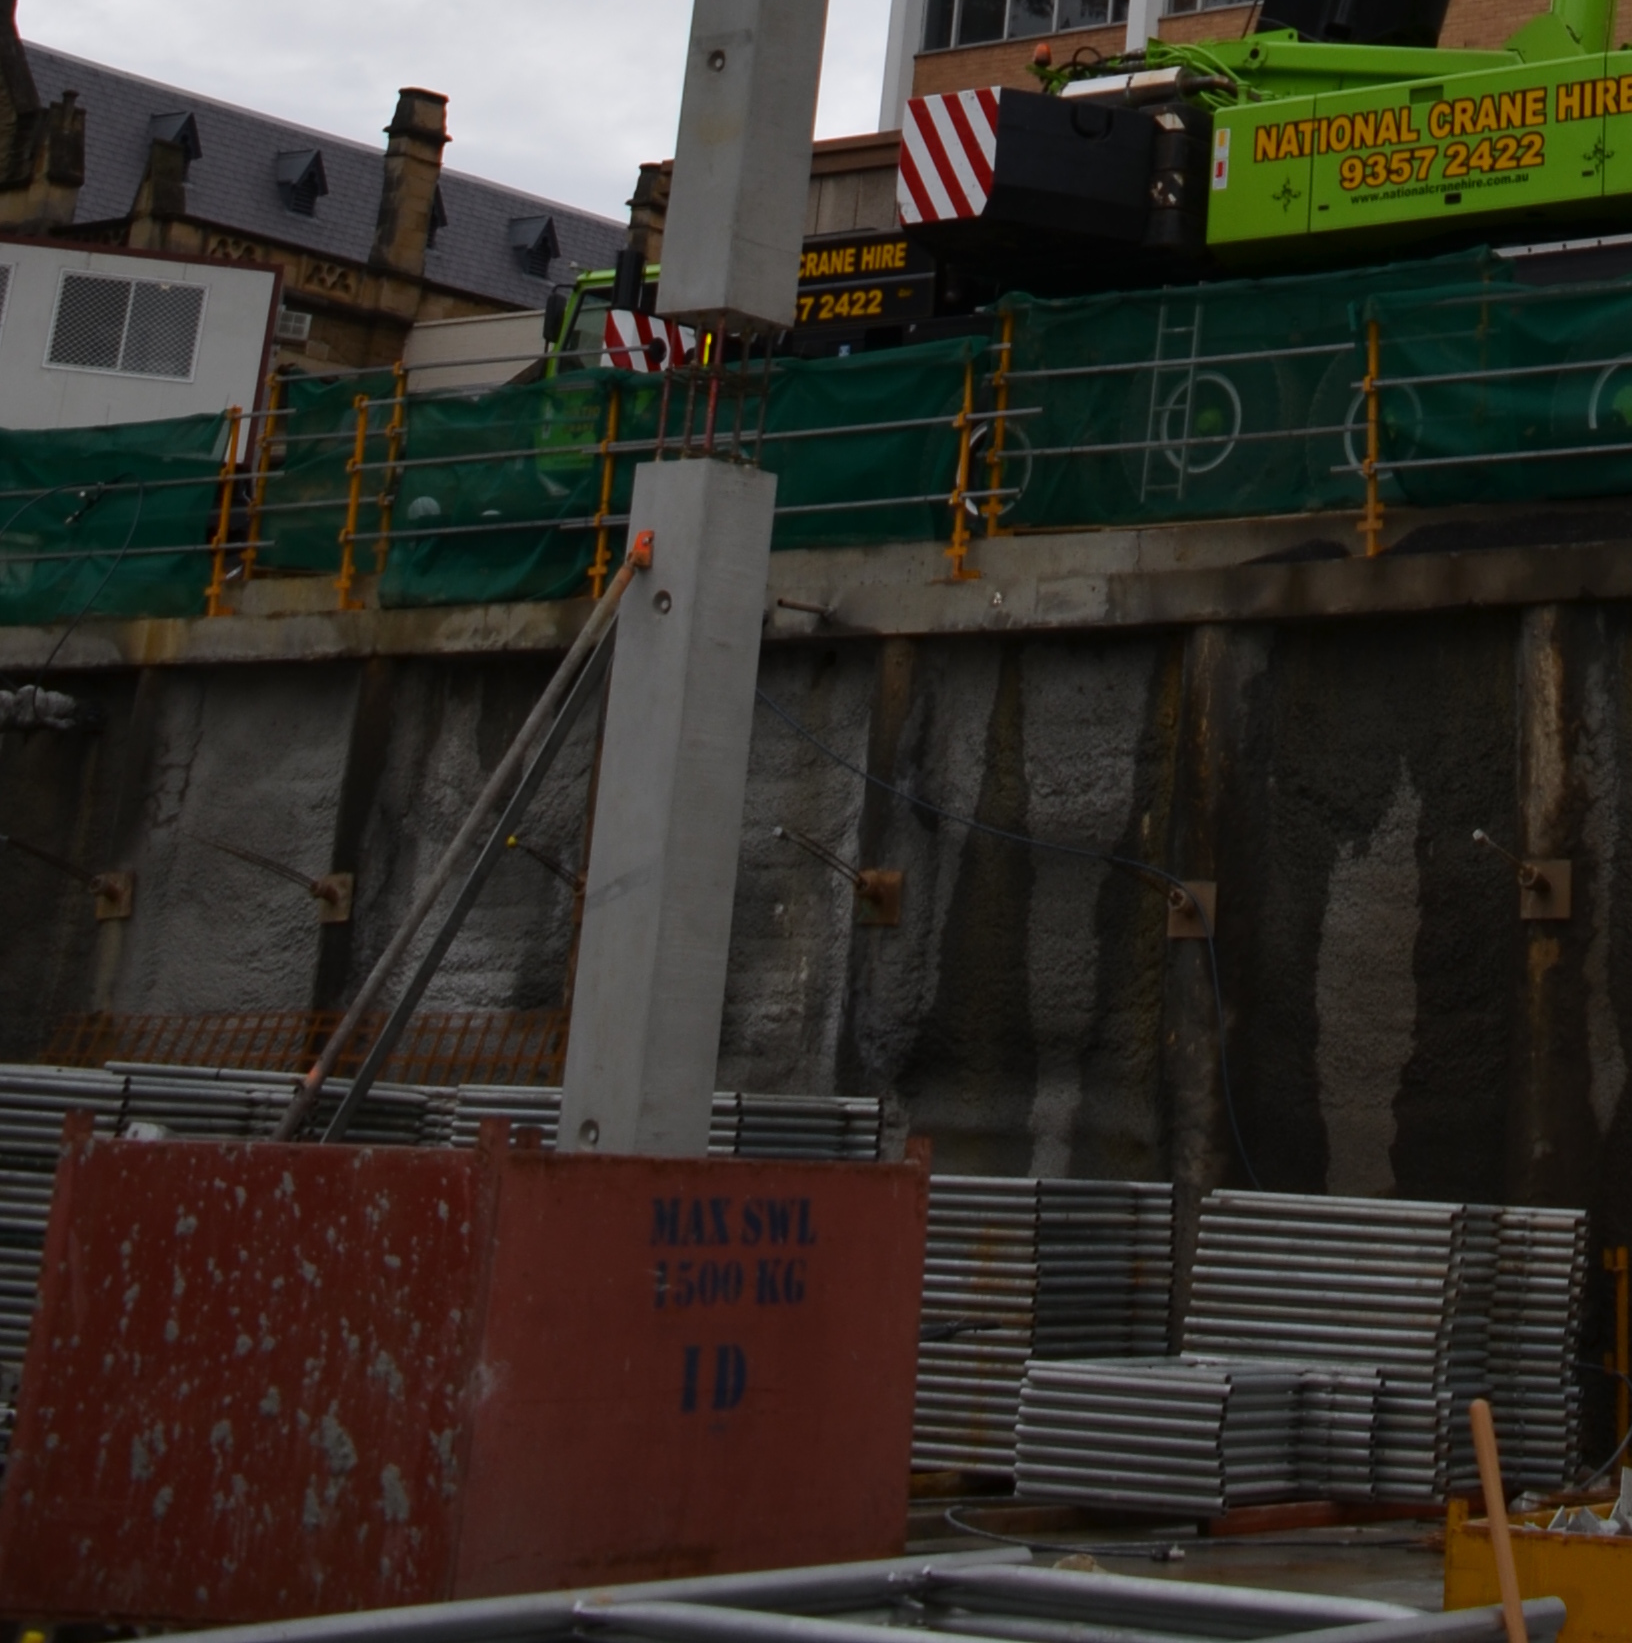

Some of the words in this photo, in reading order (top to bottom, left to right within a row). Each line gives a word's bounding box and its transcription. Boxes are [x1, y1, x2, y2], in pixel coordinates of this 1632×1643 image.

[1254, 105, 1420, 163] NATIONAL
[1428, 86, 1547, 139] CRANE
[1340, 146, 1439, 191] 9357
[1443, 132, 1545, 179] 2422
[1350, 172, 1530, 205] www.nationalcranehire.com.au
[860, 240, 908, 272] HIRE
[817, 287, 883, 321] 2422
[650, 1197, 730, 1247] MAX
[741, 1197, 817, 1246] SWL
[652, 1260, 744, 1309] 1500
[755, 1258, 806, 1305] KG
